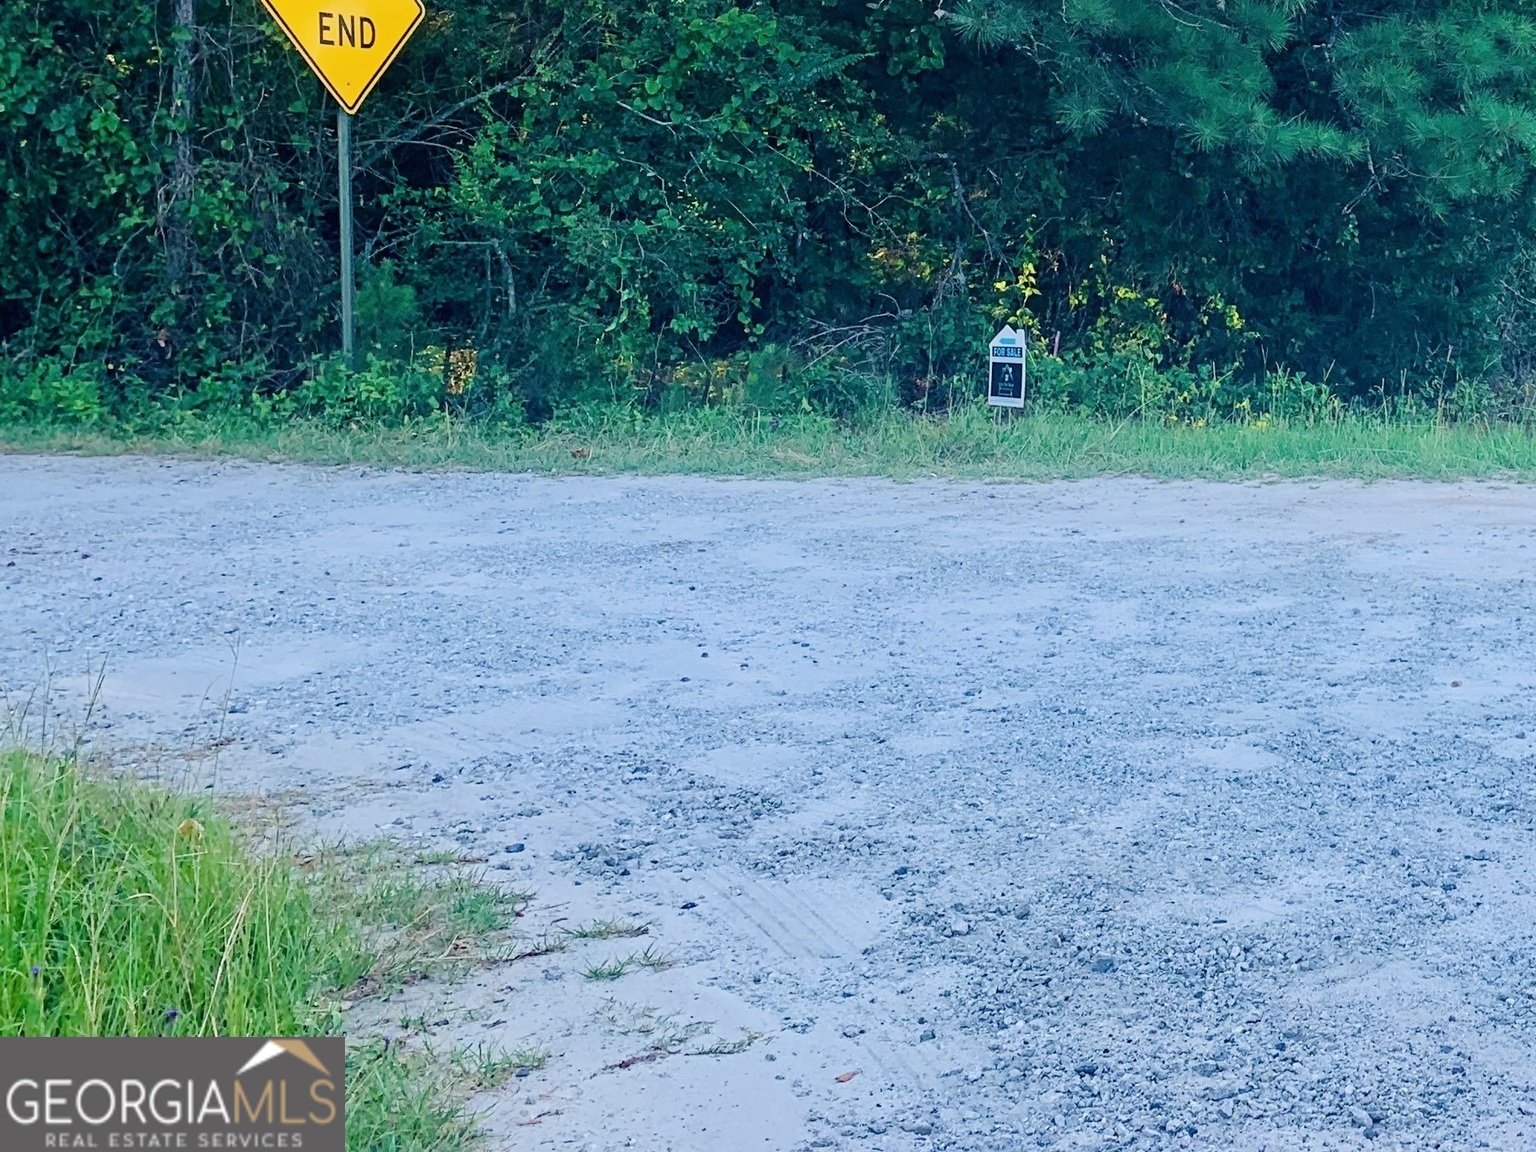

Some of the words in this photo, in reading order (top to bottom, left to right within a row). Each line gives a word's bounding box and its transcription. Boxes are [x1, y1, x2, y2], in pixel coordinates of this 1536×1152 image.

[319, 11, 376, 49] END
[993, 347, 1005, 357] FOR
[1006, 347, 1021, 357] SALE
